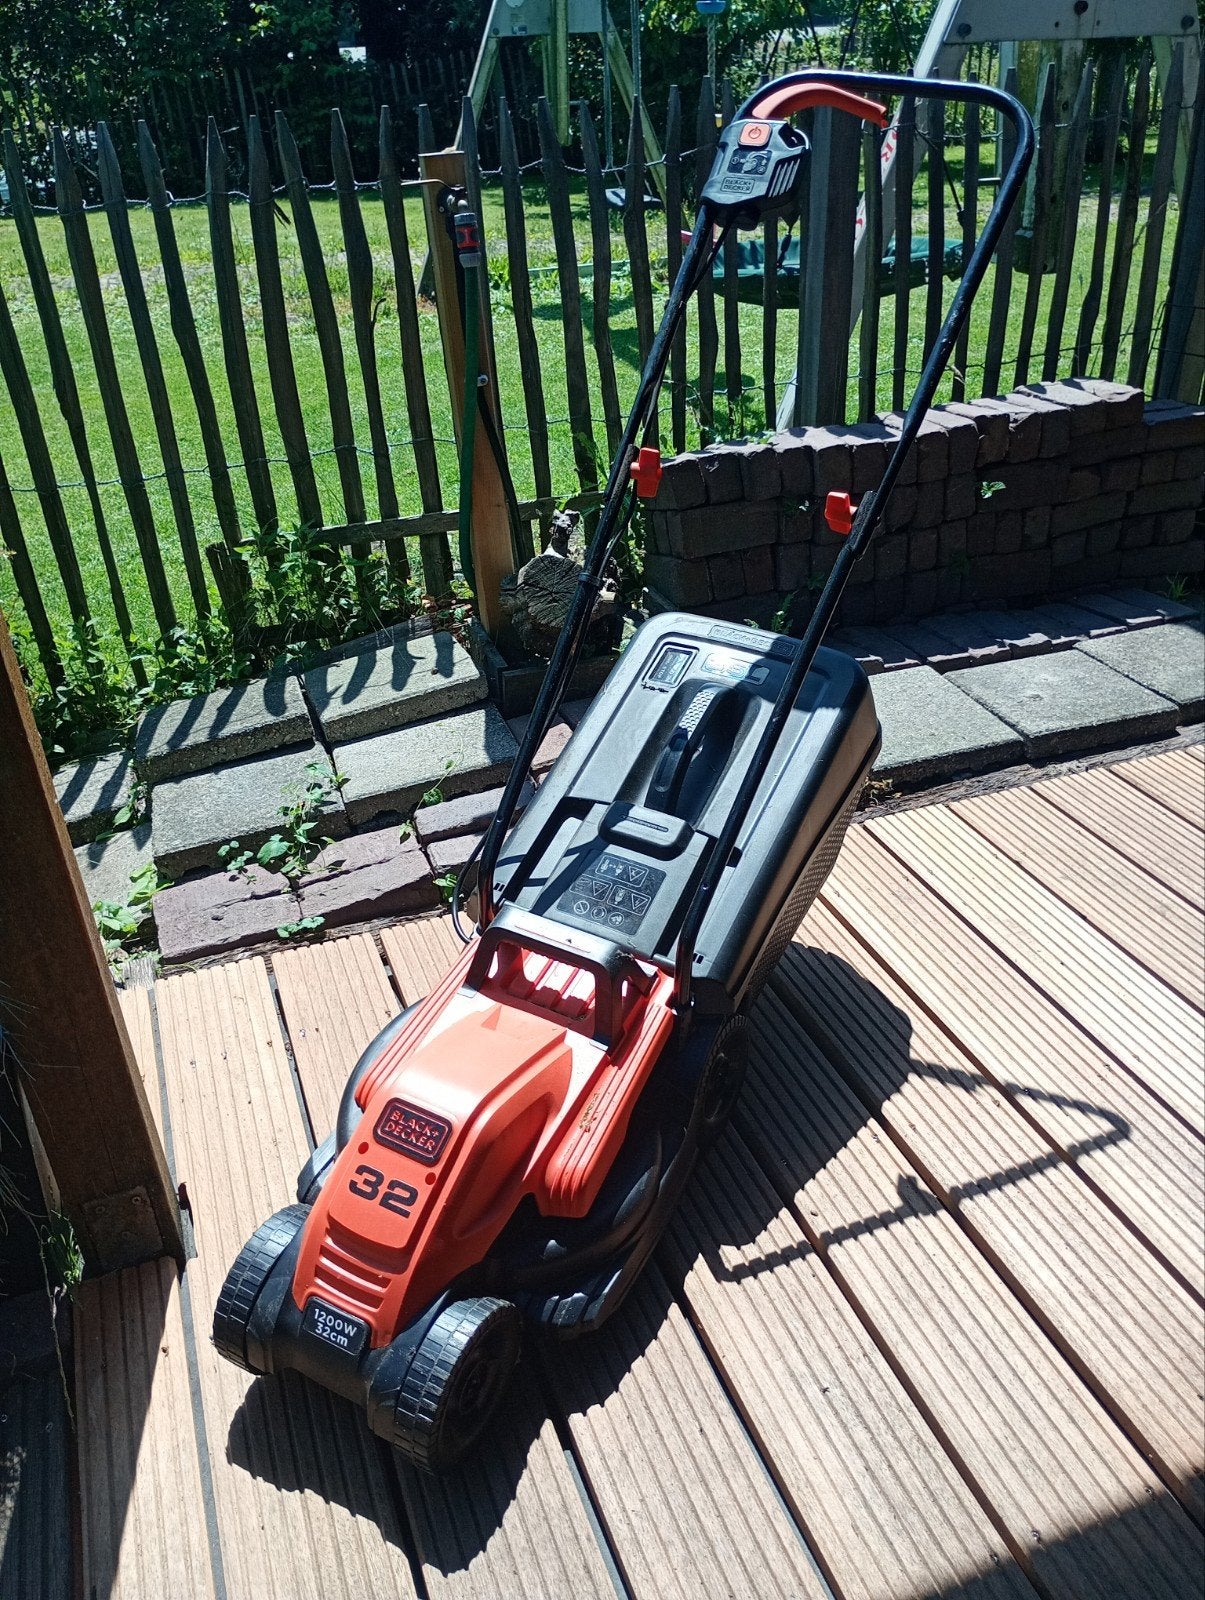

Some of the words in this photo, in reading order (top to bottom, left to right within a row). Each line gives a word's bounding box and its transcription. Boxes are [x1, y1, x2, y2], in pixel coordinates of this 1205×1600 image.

[385, 1121, 435, 1151] DECKER
[390, 1110, 439, 1137] BLACK+
[348, 1164, 419, 1219] 32
[313, 1308, 358, 1337] 1200W
[315, 1322, 348, 1347] 32cm
